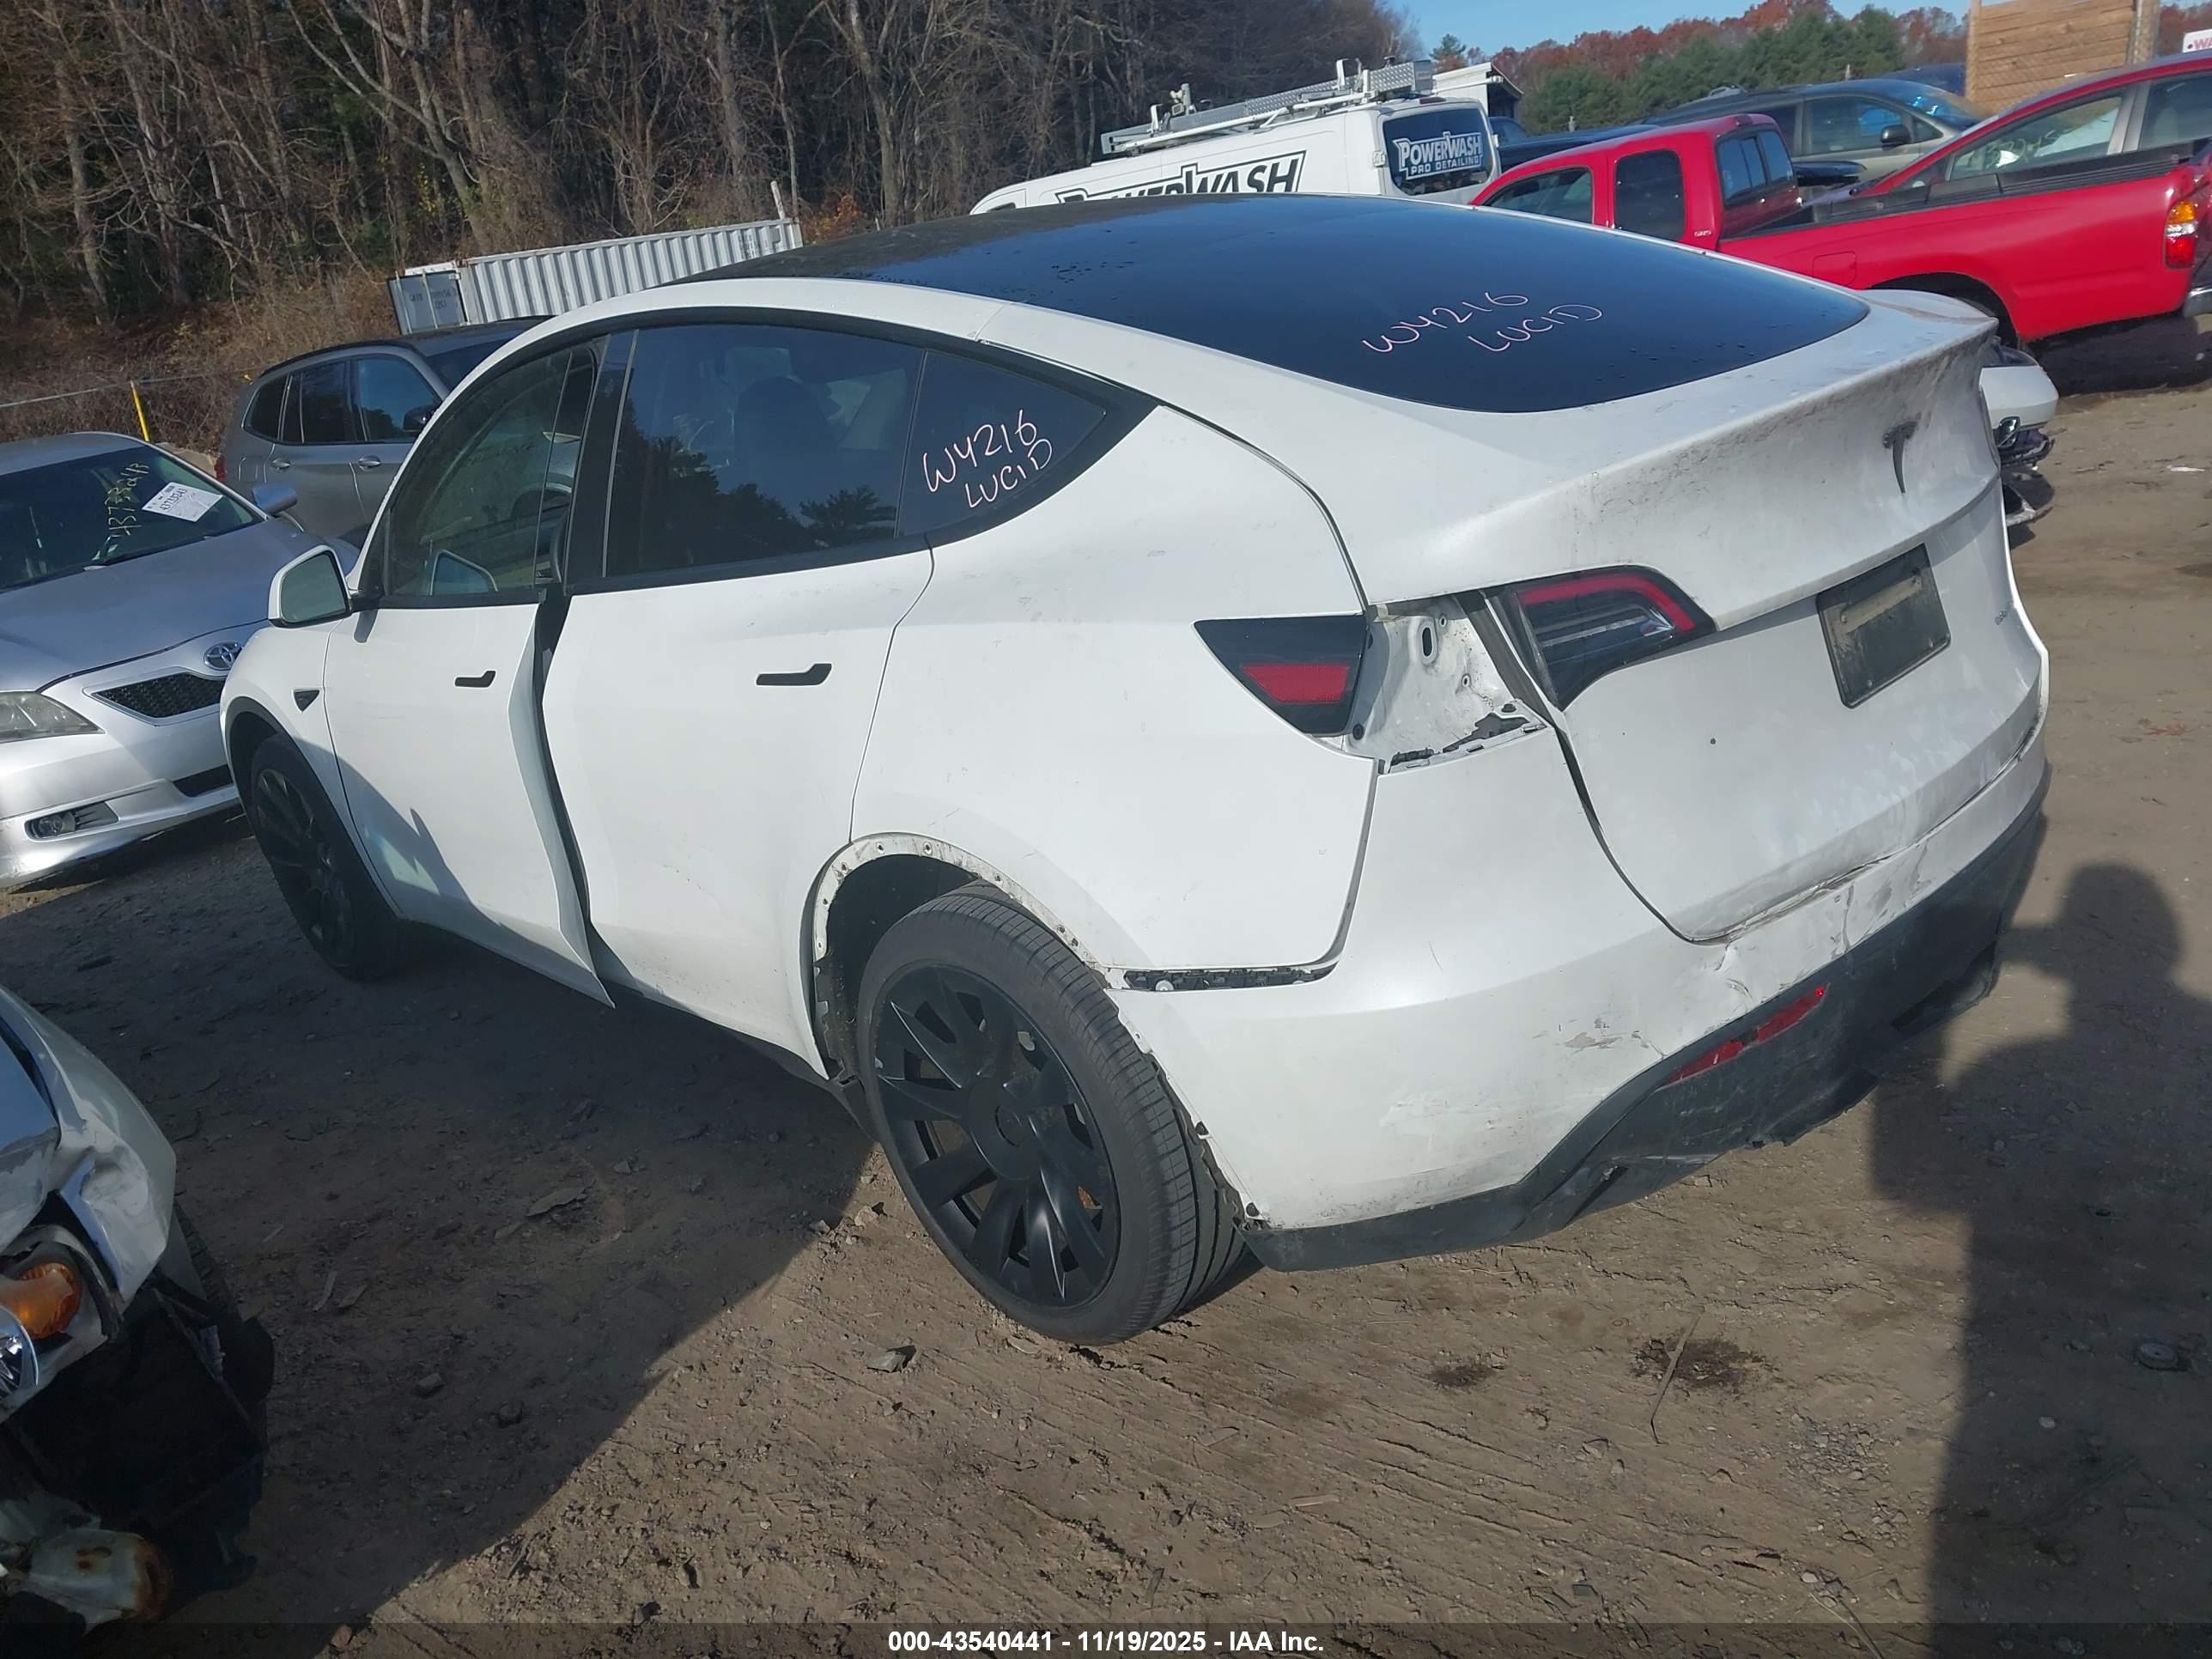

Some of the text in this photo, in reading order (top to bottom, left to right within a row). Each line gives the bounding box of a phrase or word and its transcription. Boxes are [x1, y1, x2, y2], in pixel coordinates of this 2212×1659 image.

[1411, 155, 1480, 175] PRO DETAILING
[1362, 292, 1528, 352] W4216
[1468, 304, 1602, 351] LUCID
[923, 409, 1037, 492] W4216
[965, 438, 1053, 508] LUCID
